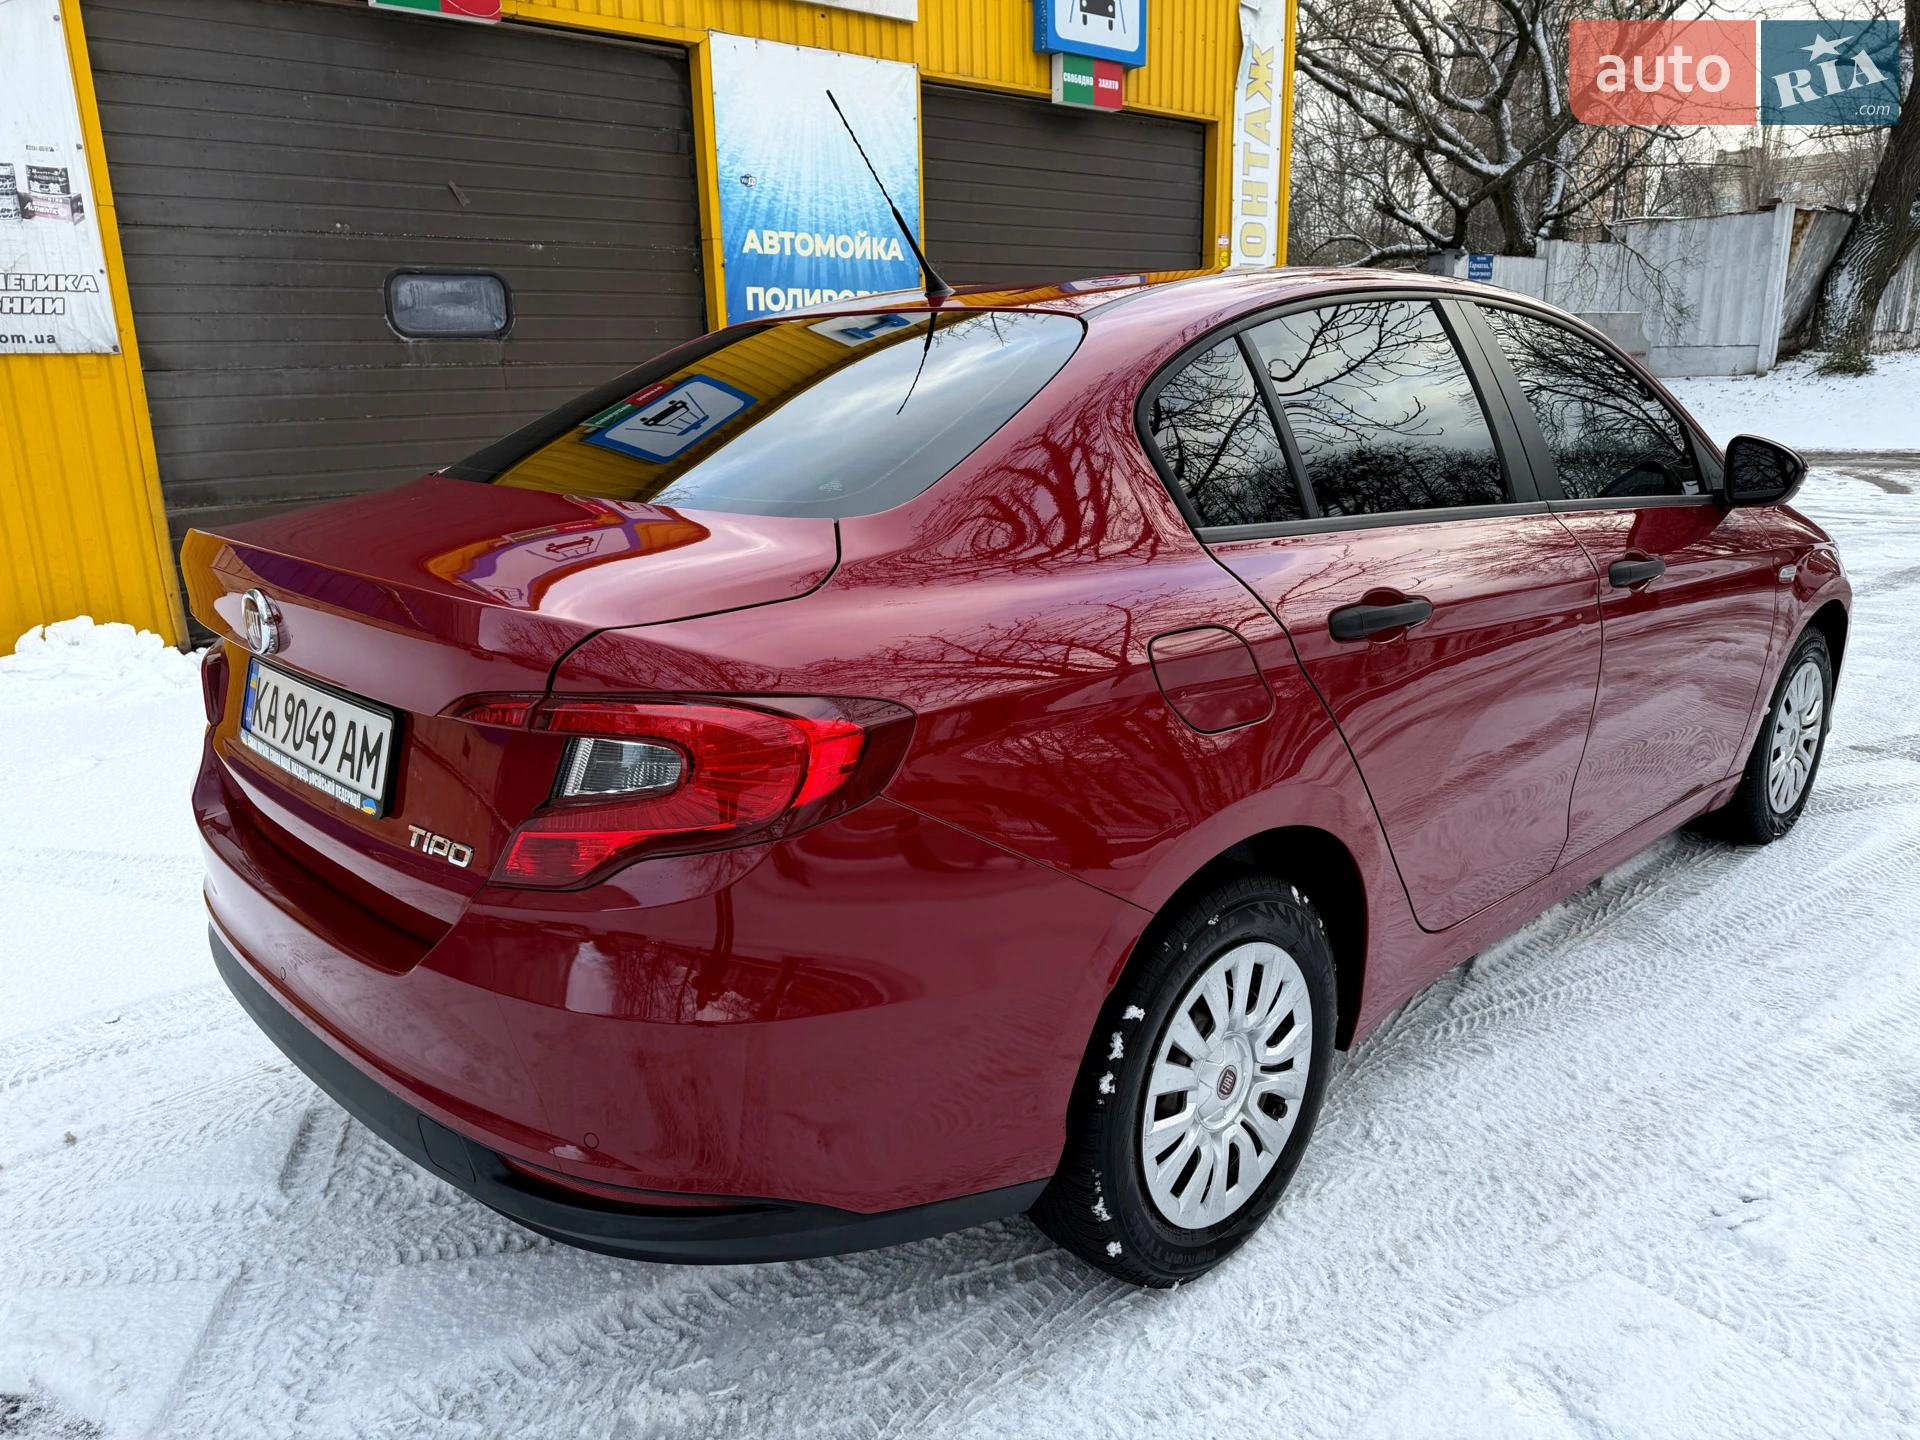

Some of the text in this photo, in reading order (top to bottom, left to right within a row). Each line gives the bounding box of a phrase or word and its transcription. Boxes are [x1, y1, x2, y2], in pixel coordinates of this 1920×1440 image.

[1063, 72, 1094, 86] СВОБОДНО
[1239, 41, 1275, 266] ОНТАЖ
[742, 229, 905, 261] АВТОМОЙКА
[0, 297, 65, 315] НИИ
[253, 677, 384, 790] KA 9049 AM
[408, 824, 475, 868] TIPO
